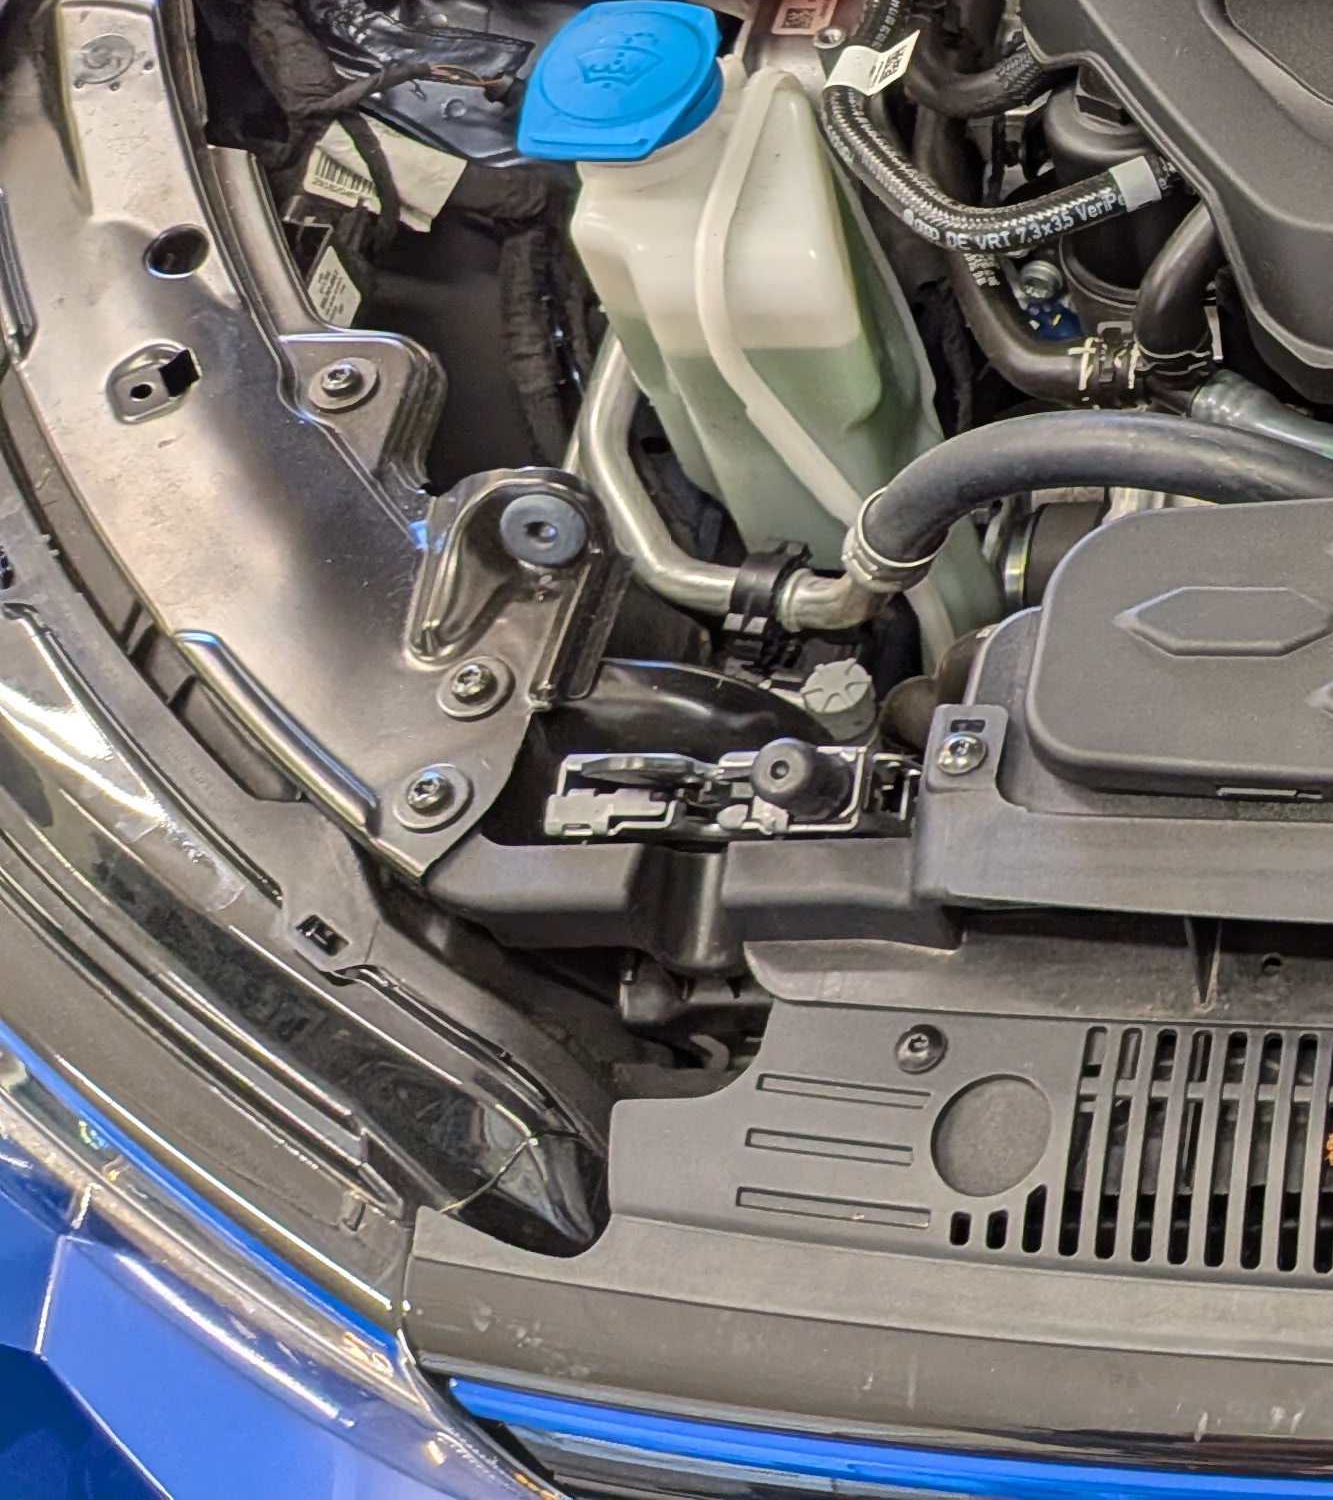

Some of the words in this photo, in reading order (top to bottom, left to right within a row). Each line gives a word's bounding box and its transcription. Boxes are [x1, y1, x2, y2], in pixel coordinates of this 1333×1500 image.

[945, 231, 971, 250] DE
[975, 231, 1011, 250] VRT
[1075, 193, 1126, 222] VeriPe
